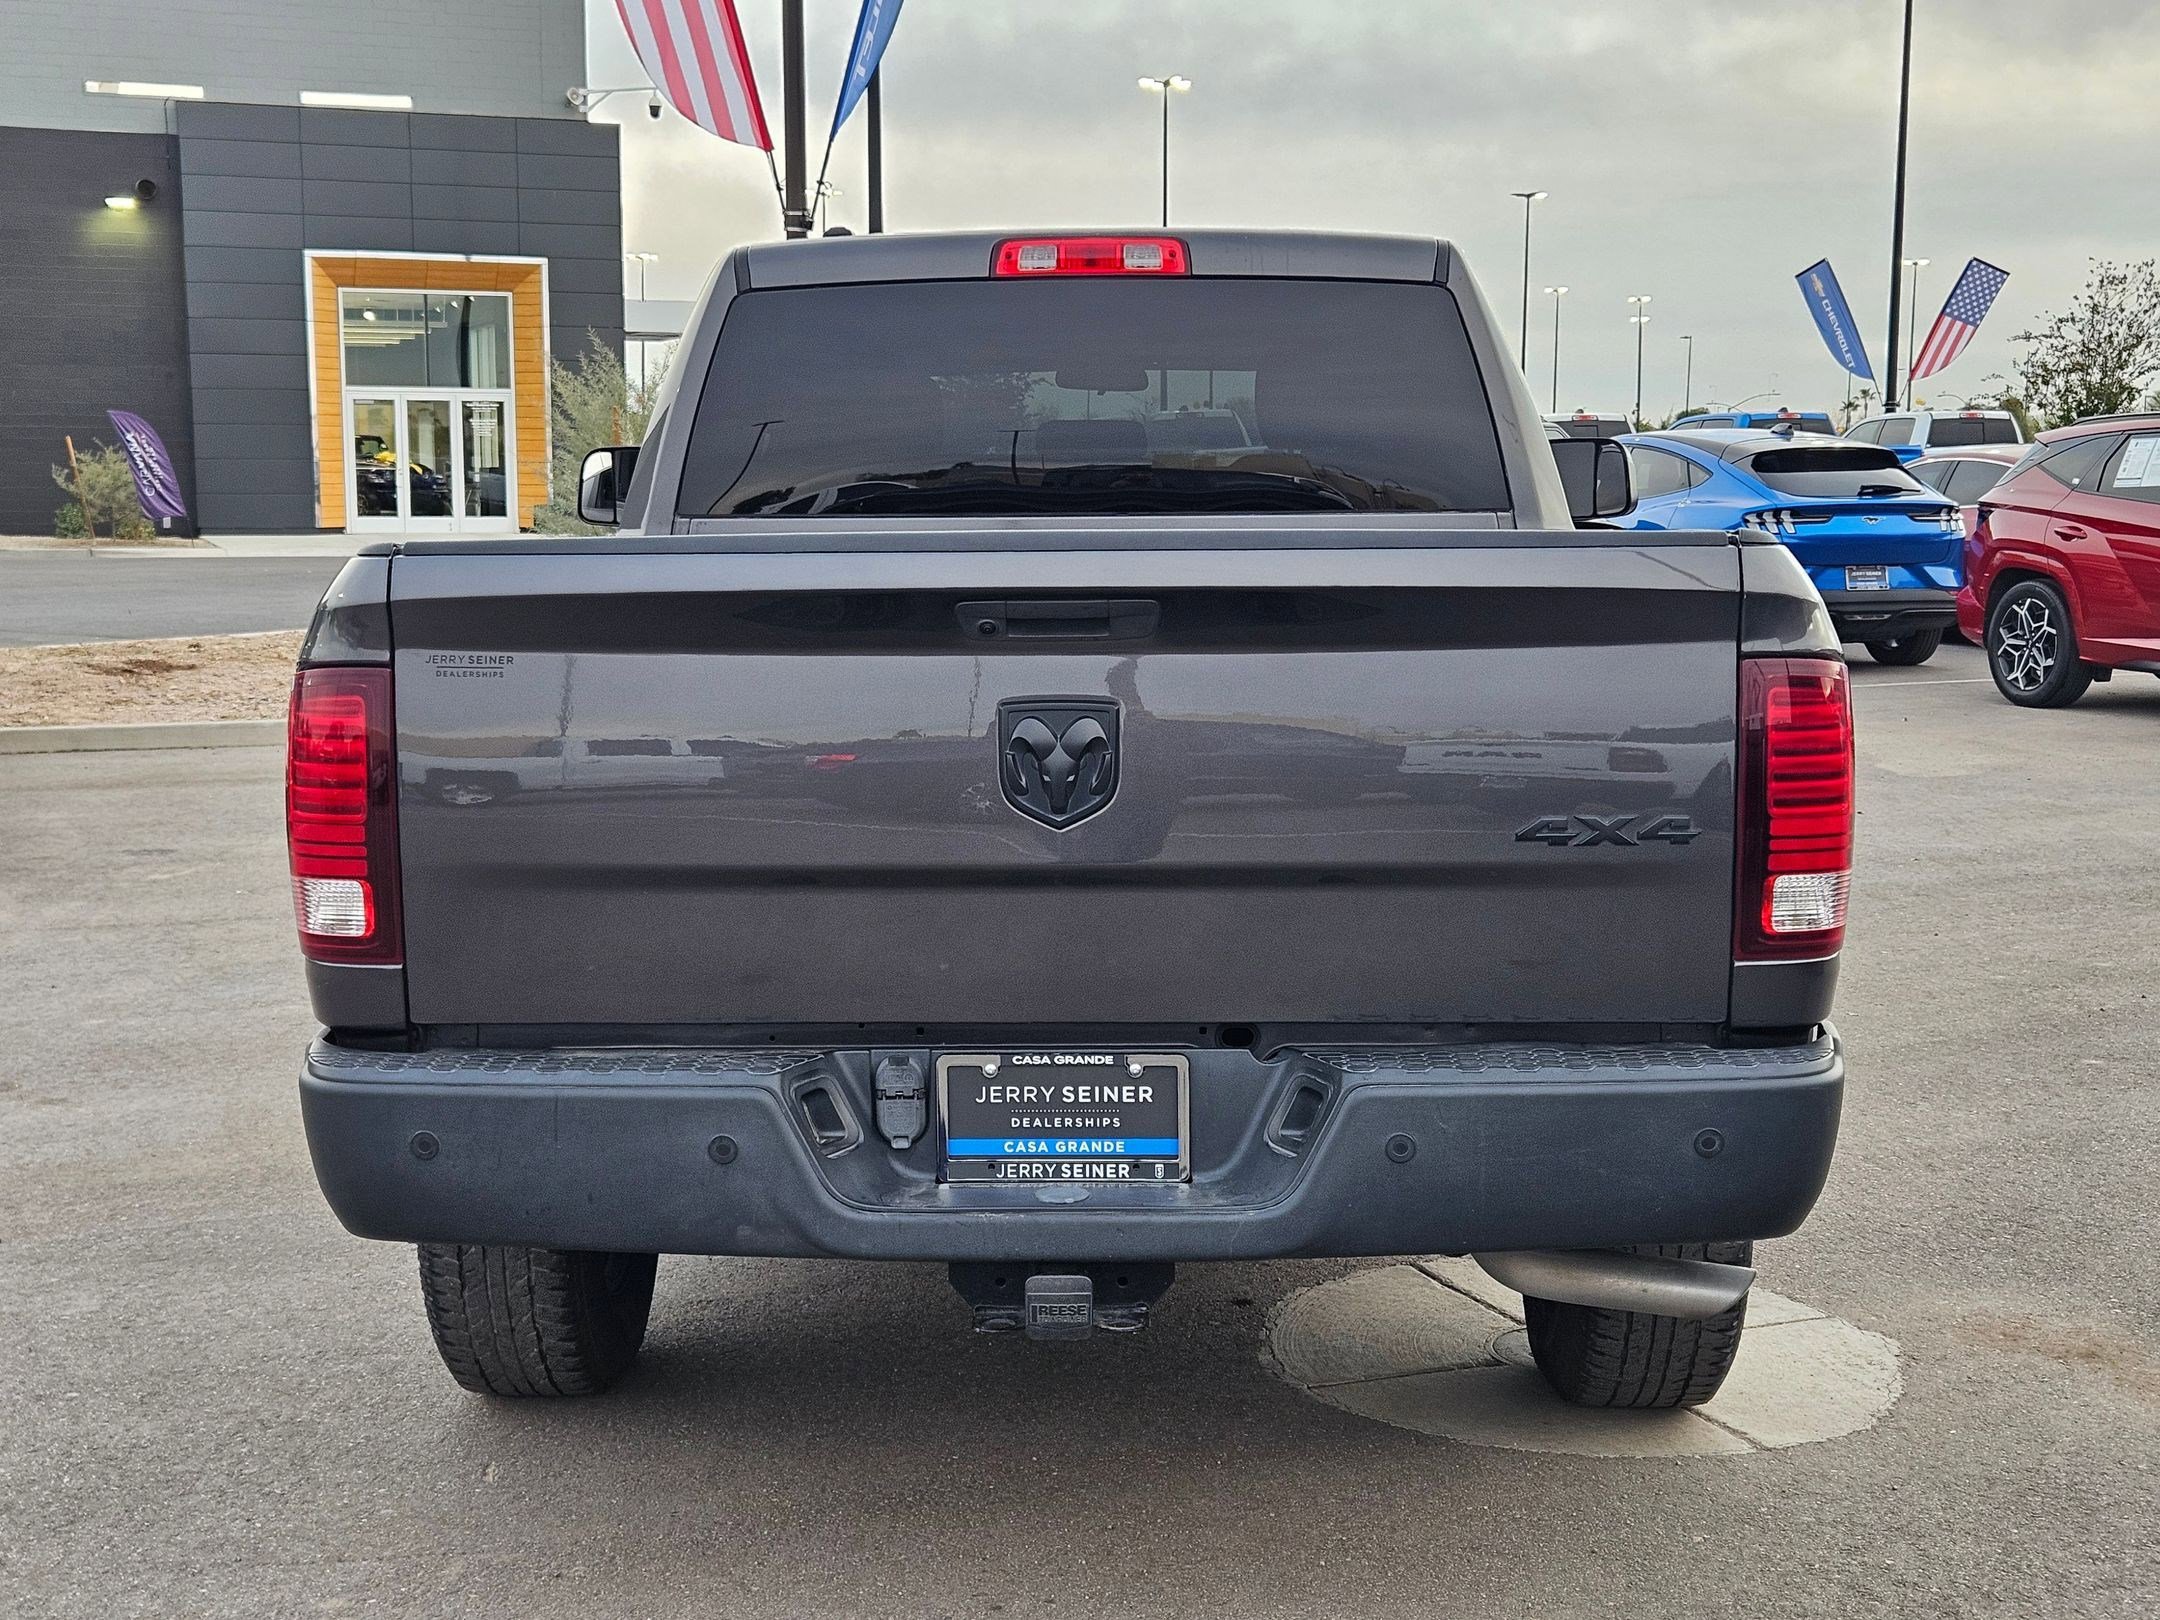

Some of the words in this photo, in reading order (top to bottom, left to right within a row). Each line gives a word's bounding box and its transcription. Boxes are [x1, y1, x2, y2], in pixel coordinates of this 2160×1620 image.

[1821, 299, 1856, 368] CHEVROLET
[425, 654, 465, 664] JERRY
[468, 655, 514, 665] SEINER
[435, 670, 504, 678] DEALERSHIPS
[1515, 815, 1702, 846] 4X4
[1012, 1055, 1051, 1065] CASA
[1053, 1055, 1114, 1065] GRANDE
[975, 1086, 1055, 1103] JERRY
[1062, 1086, 1153, 1103] SEINER
[1011, 1117, 1121, 1128] DEALERSHIPS
[1004, 1141, 1049, 1153] CASA
[1055, 1141, 1125, 1153] GRANDE
[996, 1163, 1056, 1178] JERRY
[1061, 1163, 1130, 1178] SEINER
[1038, 1305, 1087, 1316] REESE
